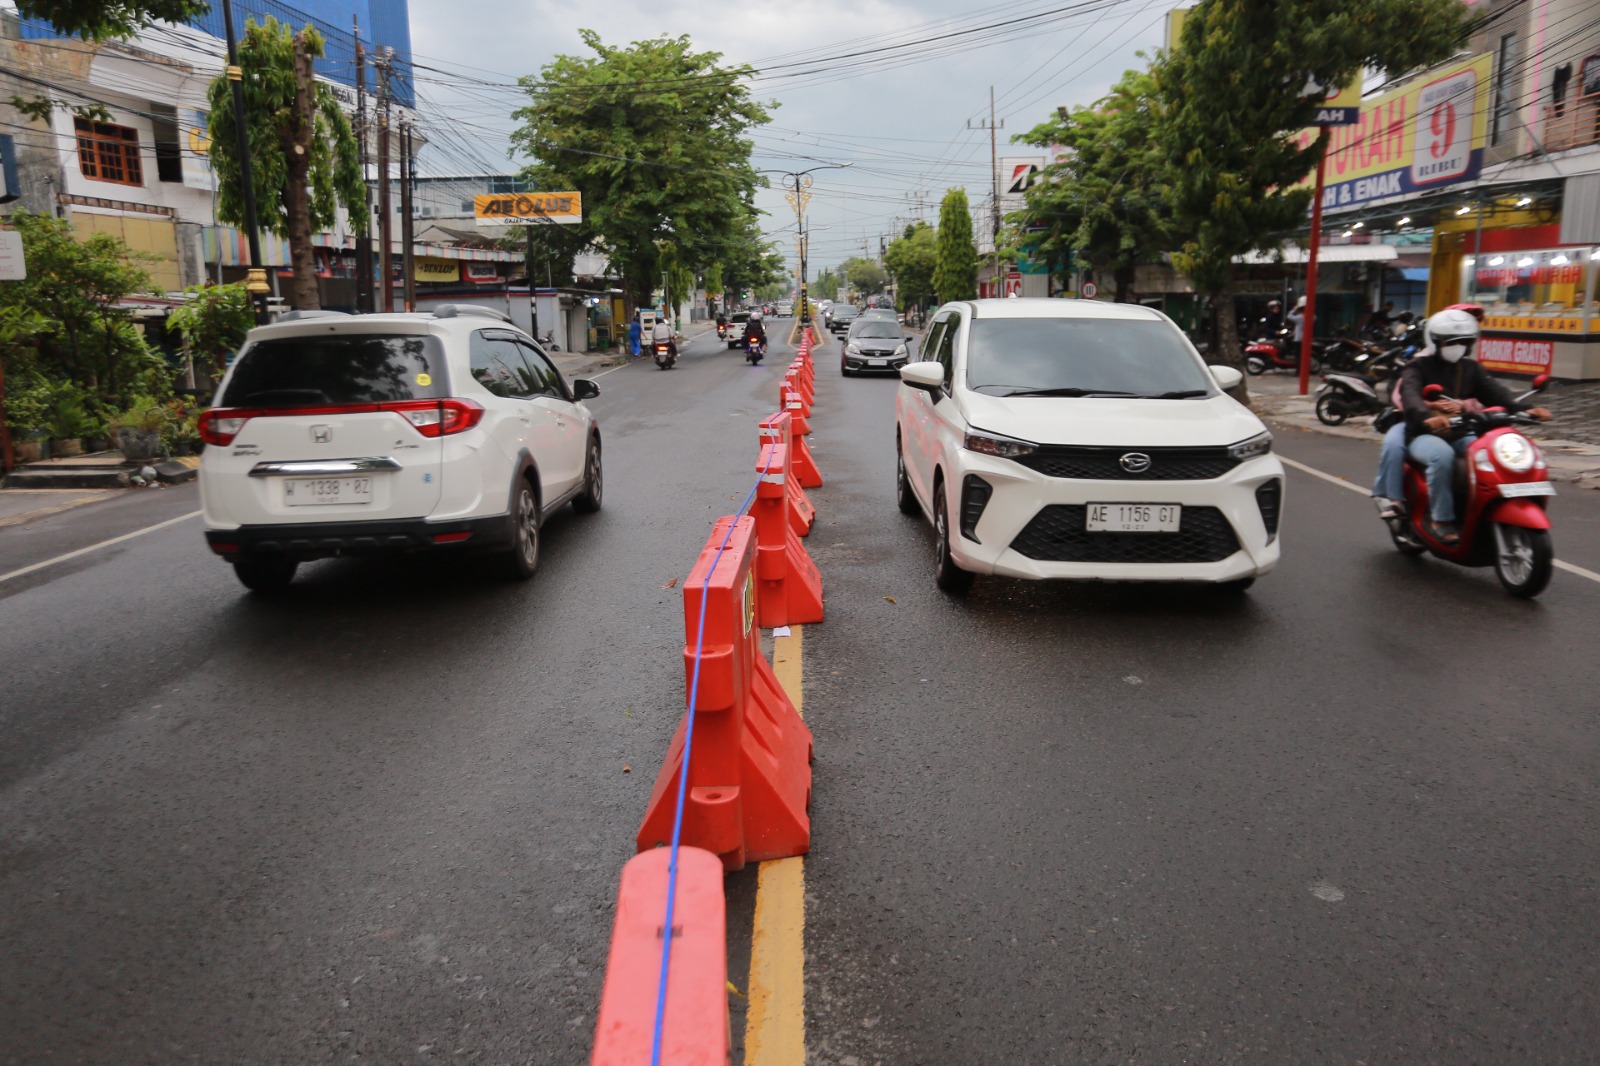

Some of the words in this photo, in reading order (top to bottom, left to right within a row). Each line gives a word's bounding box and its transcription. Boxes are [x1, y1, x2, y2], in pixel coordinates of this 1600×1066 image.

[1430, 101, 1456, 158] 9
[1419, 157, 1462, 177] RIBU
[1354, 171, 1403, 200] ENAK
[482, 196, 572, 214] AEOLUS
[423, 263, 455, 274] DUNLOP
[1481, 339, 1513, 361] PARKIR
[1514, 341, 1551, 366] GRATIS
[311, 480, 340, 496] 1338
[1091, 506, 1108, 522] AE
[1119, 506, 1151, 523] 1156
[1159, 507, 1174, 523] GI
